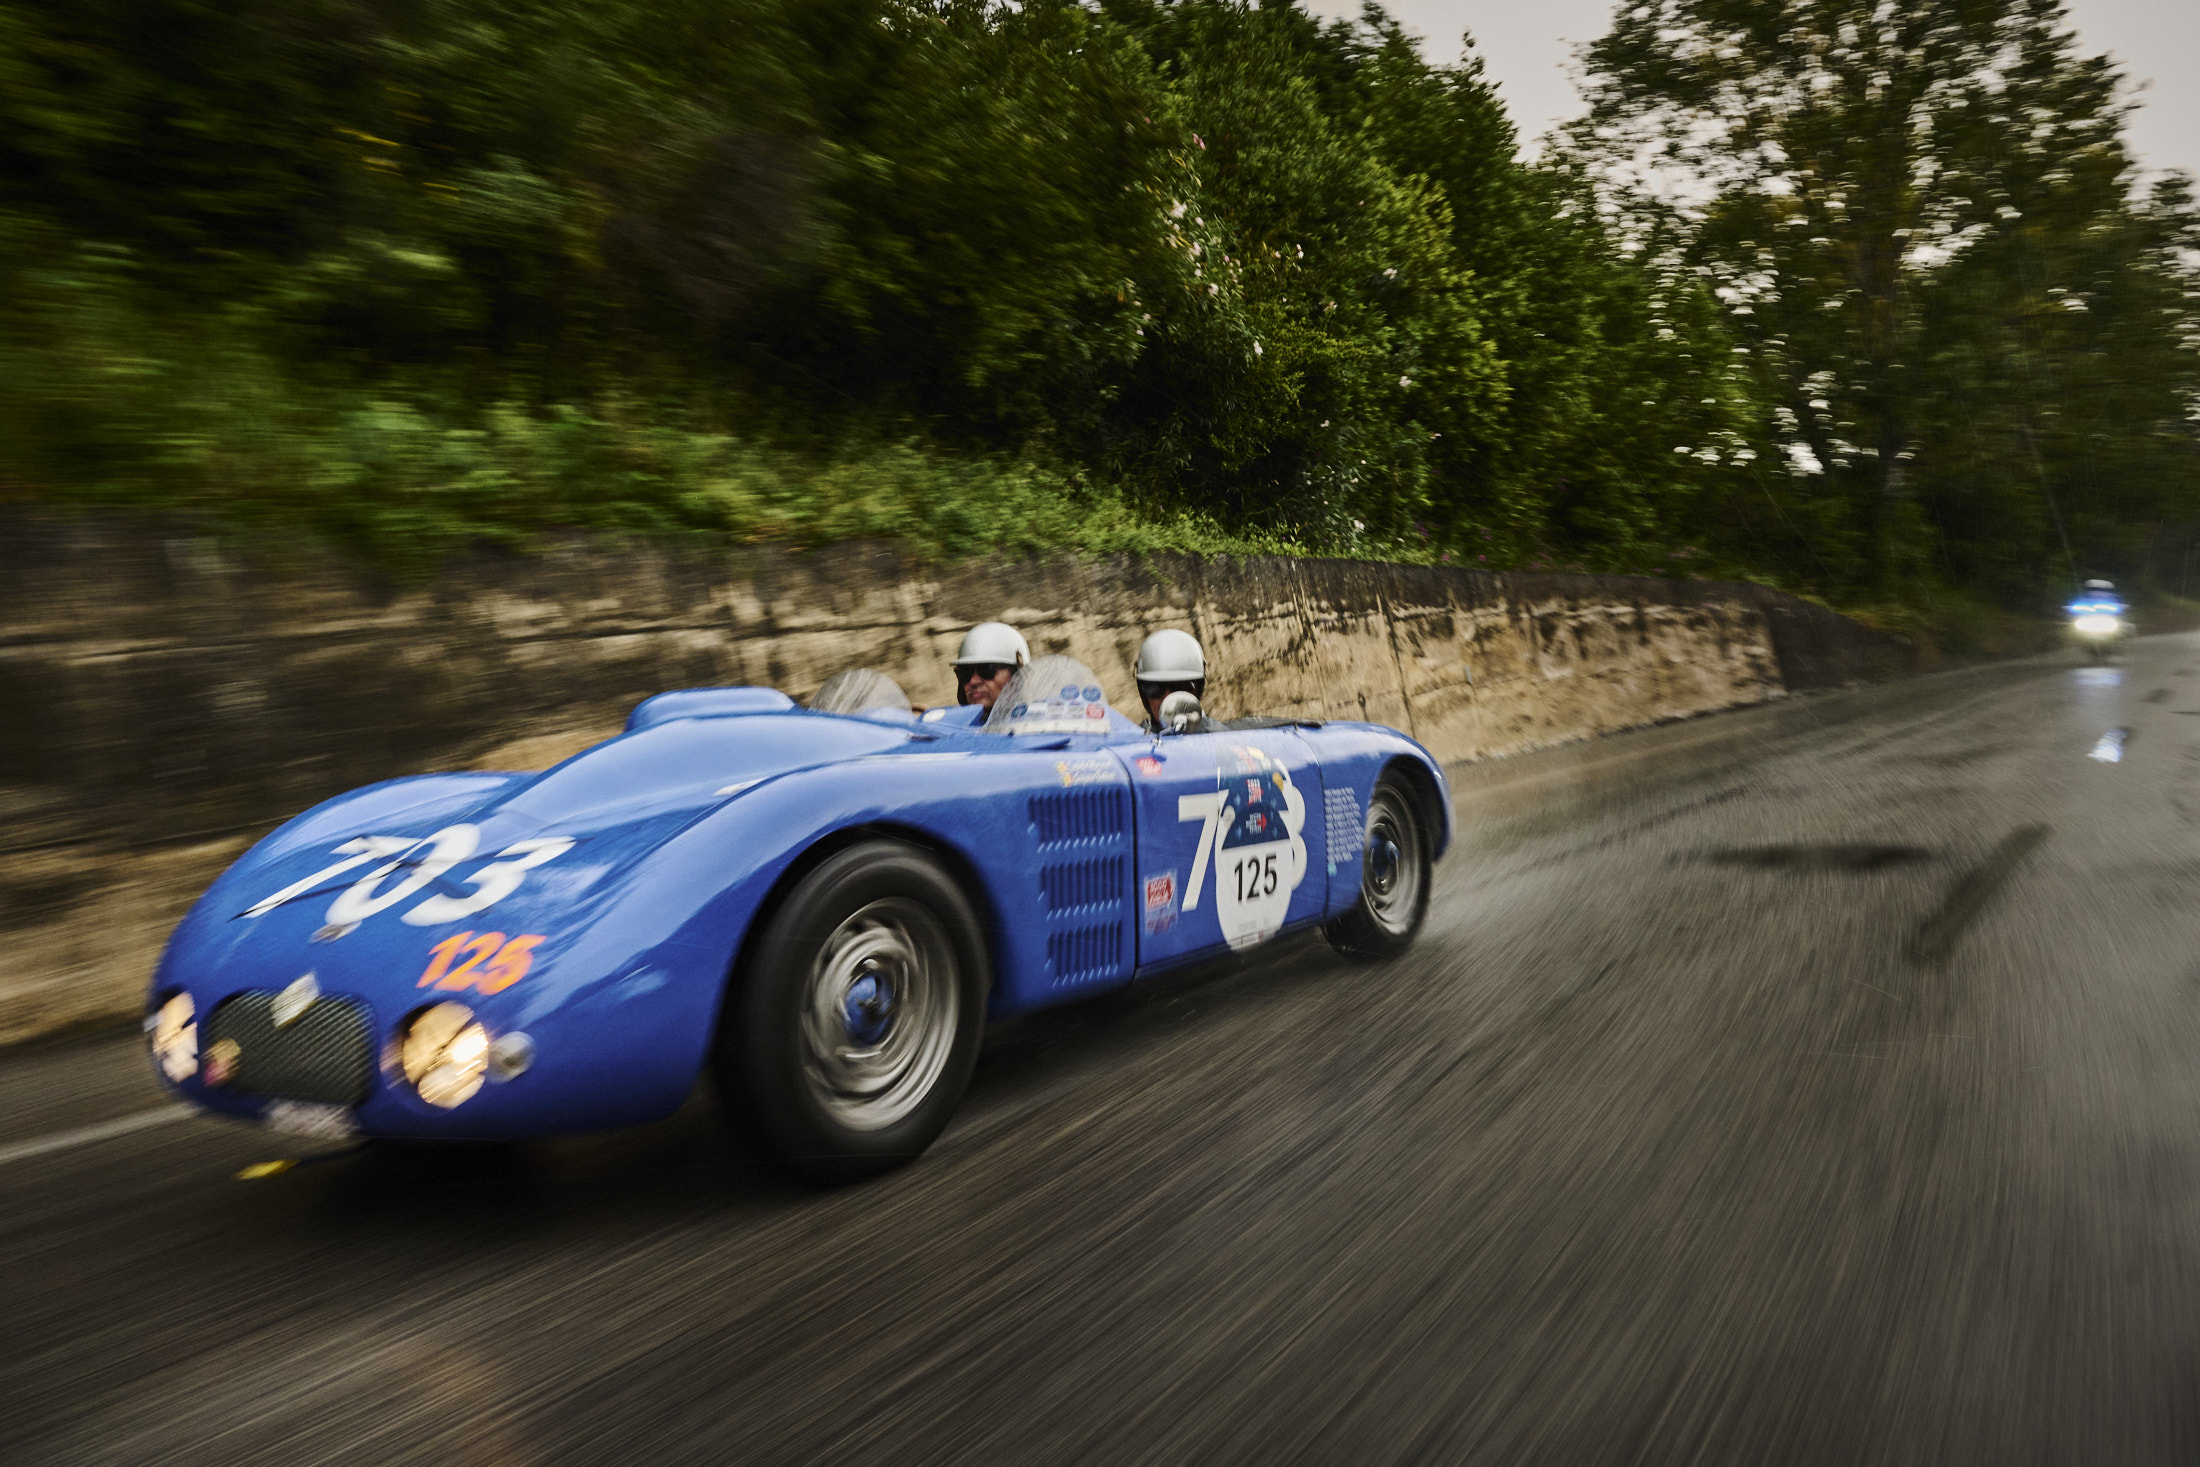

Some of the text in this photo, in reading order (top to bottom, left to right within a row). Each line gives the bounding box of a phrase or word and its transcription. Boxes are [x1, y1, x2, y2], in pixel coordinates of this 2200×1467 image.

[243, 823, 576, 926] 703
[1234, 853, 1278, 903] 125
[415, 930, 547, 996] 125
